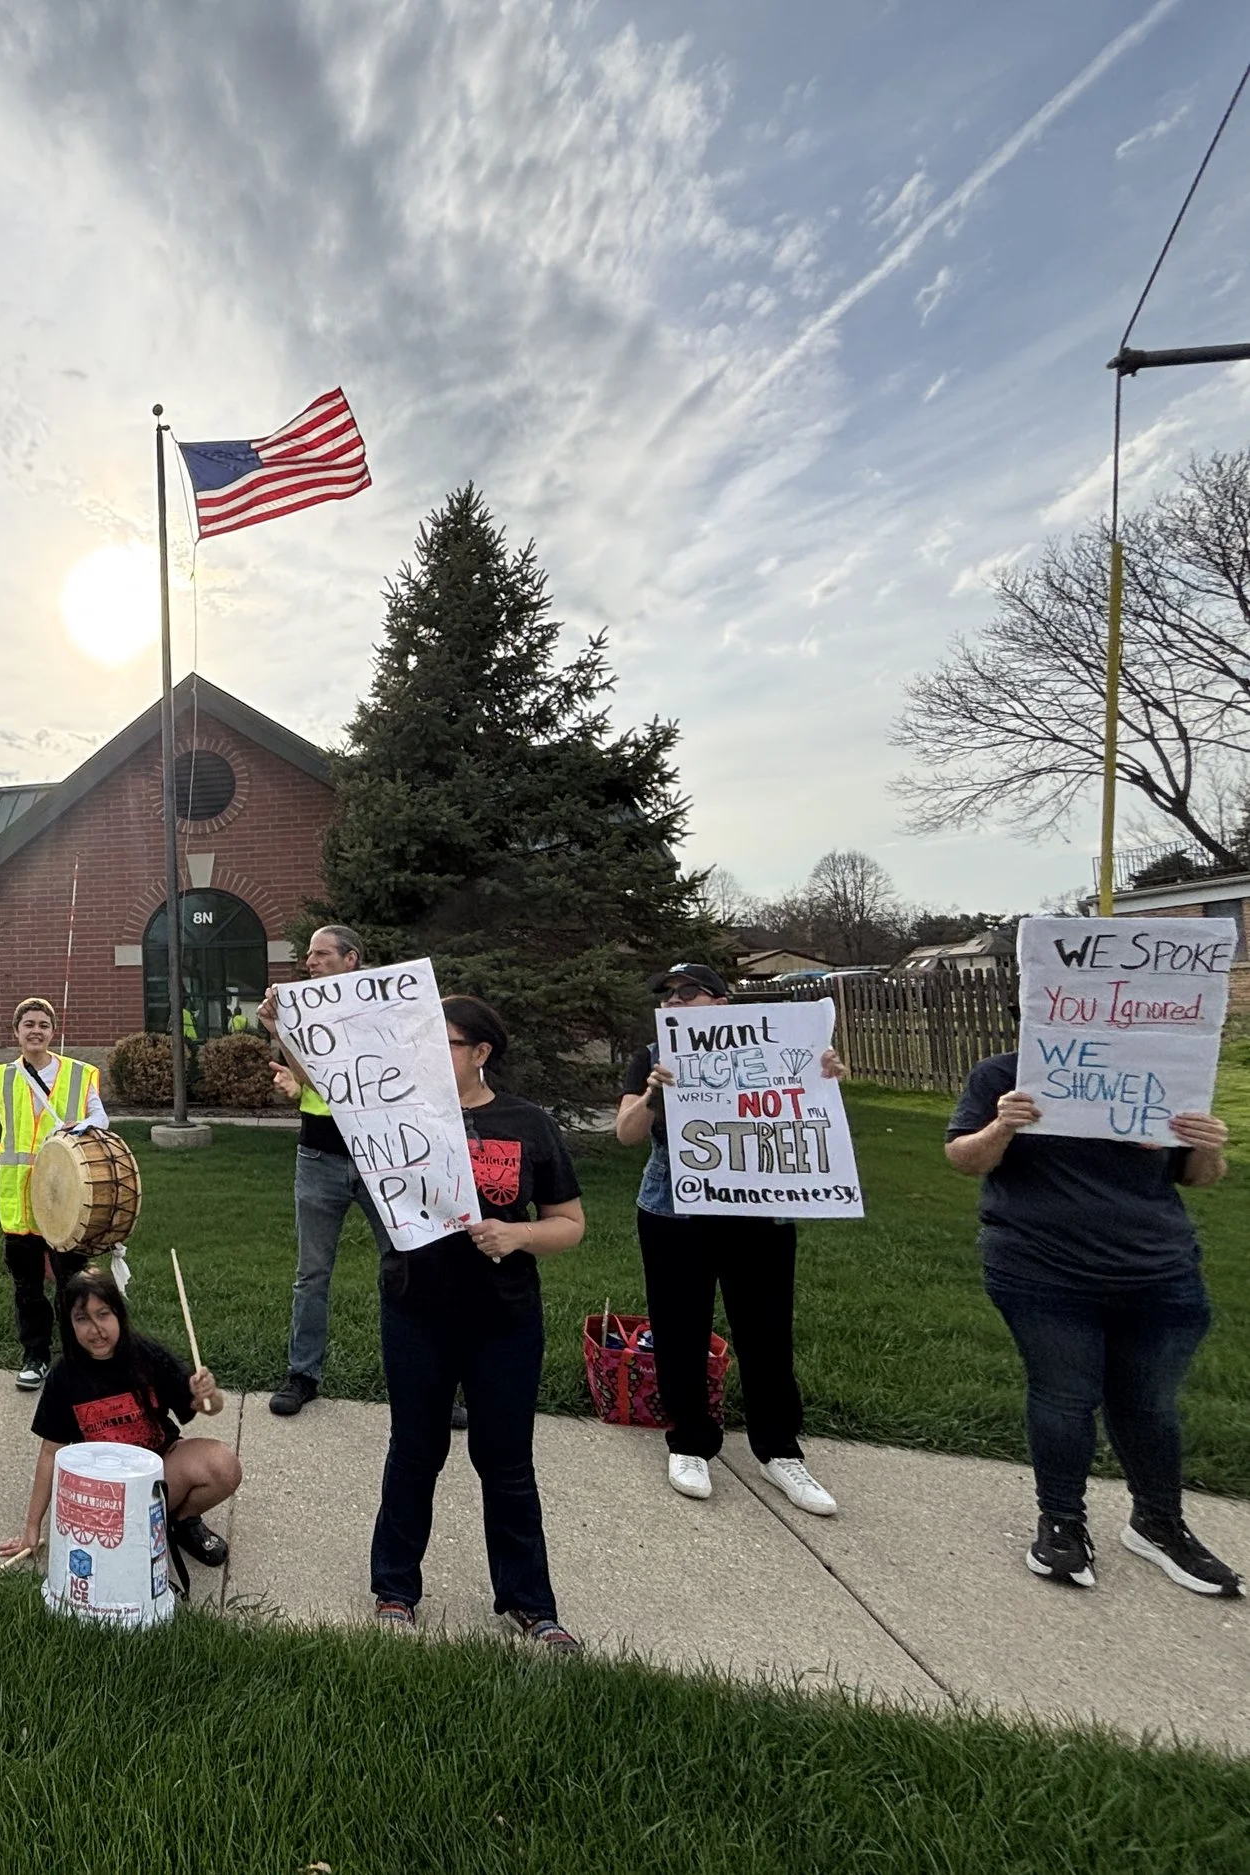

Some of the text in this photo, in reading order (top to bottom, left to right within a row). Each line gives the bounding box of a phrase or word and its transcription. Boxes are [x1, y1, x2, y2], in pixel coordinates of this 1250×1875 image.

[193, 911, 213, 924] 8N
[1054, 933, 1233, 974] WE SPOKE
[356, 973, 419, 1001] are
[666, 1016, 780, 1052] i want
[676, 1048, 803, 1090] ICE on my
[1037, 1038, 1110, 1068] WE
[1041, 1069, 1166, 1104] SHOWED
[738, 1088, 805, 1119] NOT
[808, 1107, 828, 1119] my
[350, 1122, 430, 1170] AND
[680, 1120, 831, 1174] STREET
[70, 1576, 88, 1591] NO
[70, 1589, 88, 1603] ICE
